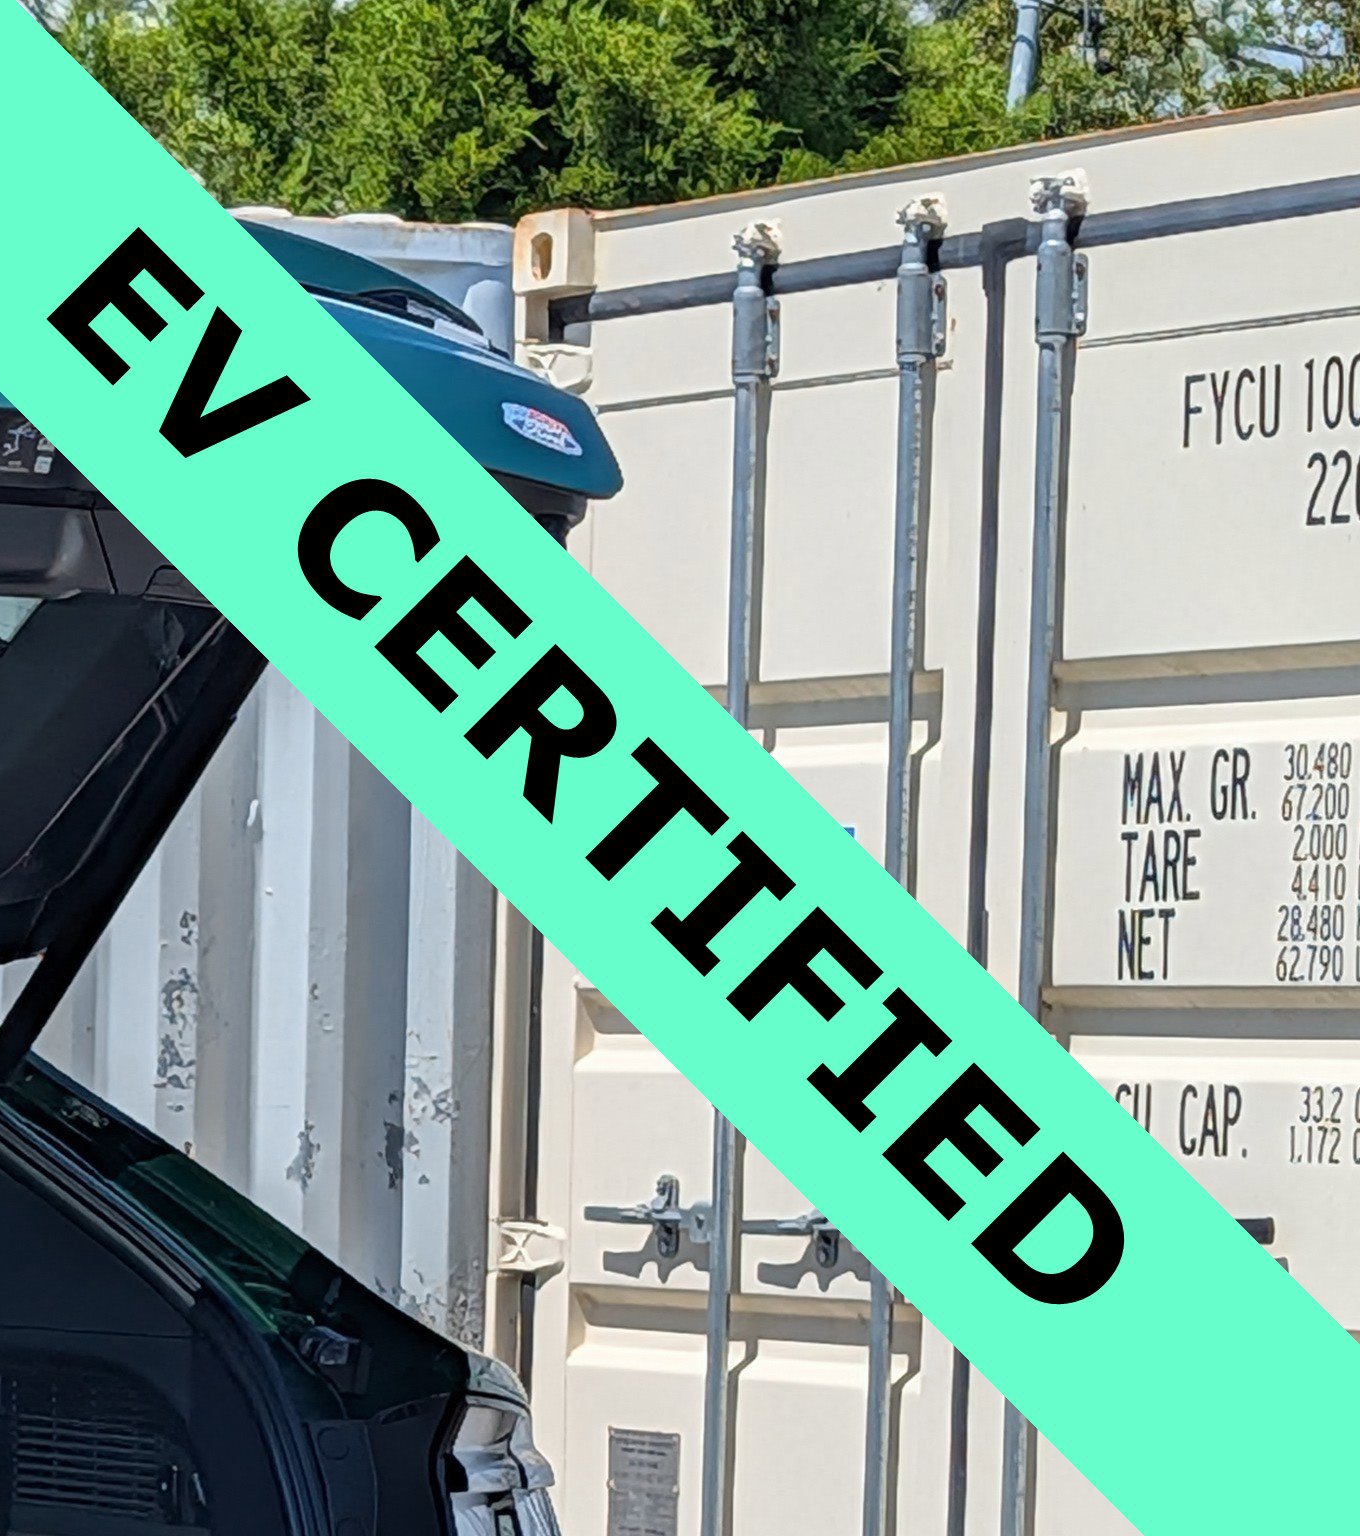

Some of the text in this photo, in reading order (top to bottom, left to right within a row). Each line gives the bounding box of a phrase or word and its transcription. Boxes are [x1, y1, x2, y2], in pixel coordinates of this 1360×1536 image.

[1183, 364, 1281, 448] FYCU
[1305, 449, 1360, 526] 22
[1121, 751, 1191, 825] MAX.
[1210, 747, 1256, 821] GR.
[1121, 828, 1201, 903] TARE
[1117, 908, 1176, 981] NET
[1179, 1084, 1247, 1158] CAP.
